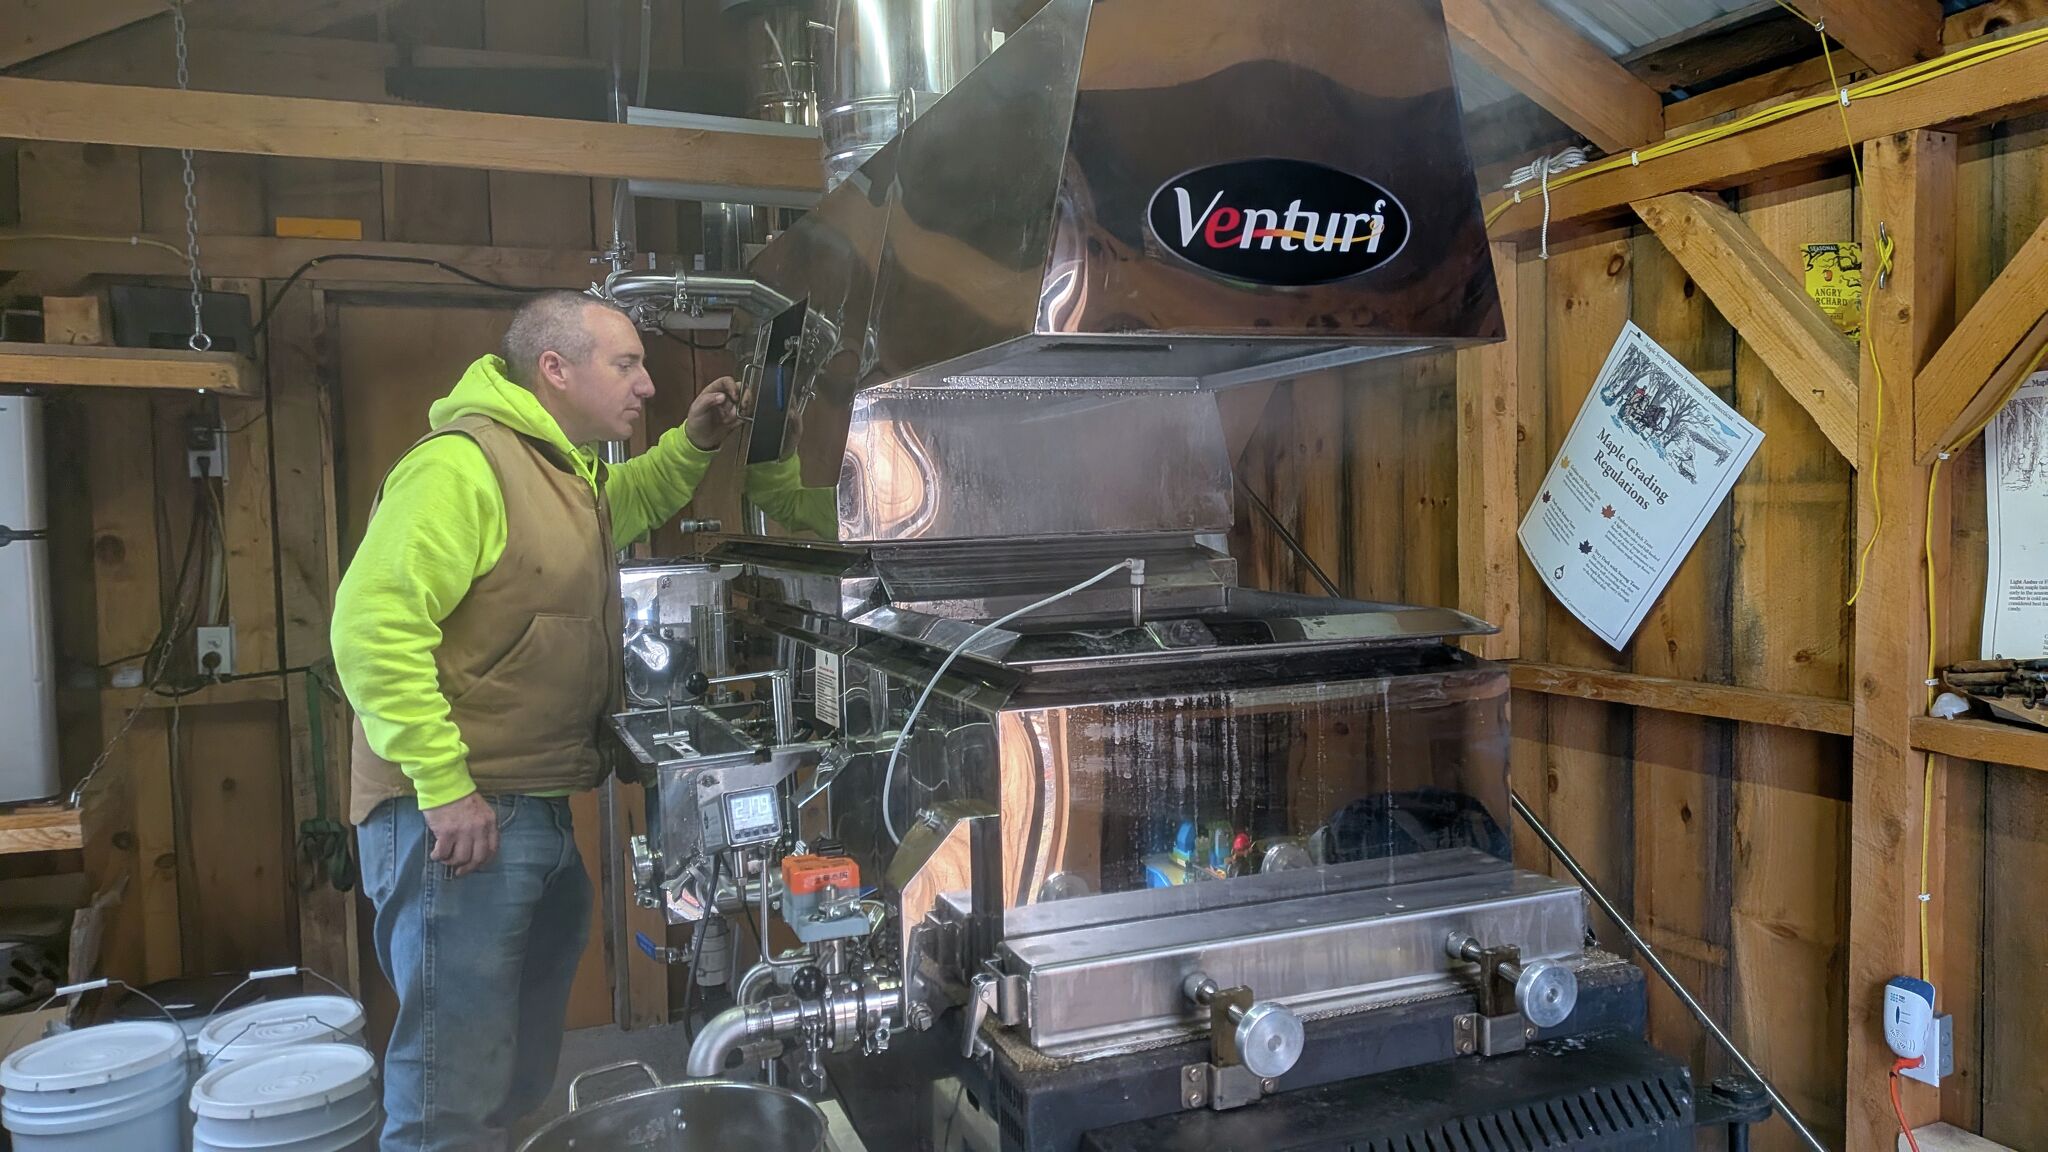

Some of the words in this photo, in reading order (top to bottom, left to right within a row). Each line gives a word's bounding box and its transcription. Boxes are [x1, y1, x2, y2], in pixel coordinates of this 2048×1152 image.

[1174, 187, 1386, 253] Venturi
[1814, 288, 1842, 297] ANGRY
[1816, 297, 1848, 306] RCHARD
[1644, 342, 1656, 354] Maple
[1594, 450, 1650, 510] Regulations
[1596, 427, 1626, 462] Maple
[1626, 458, 1668, 504] Grading
